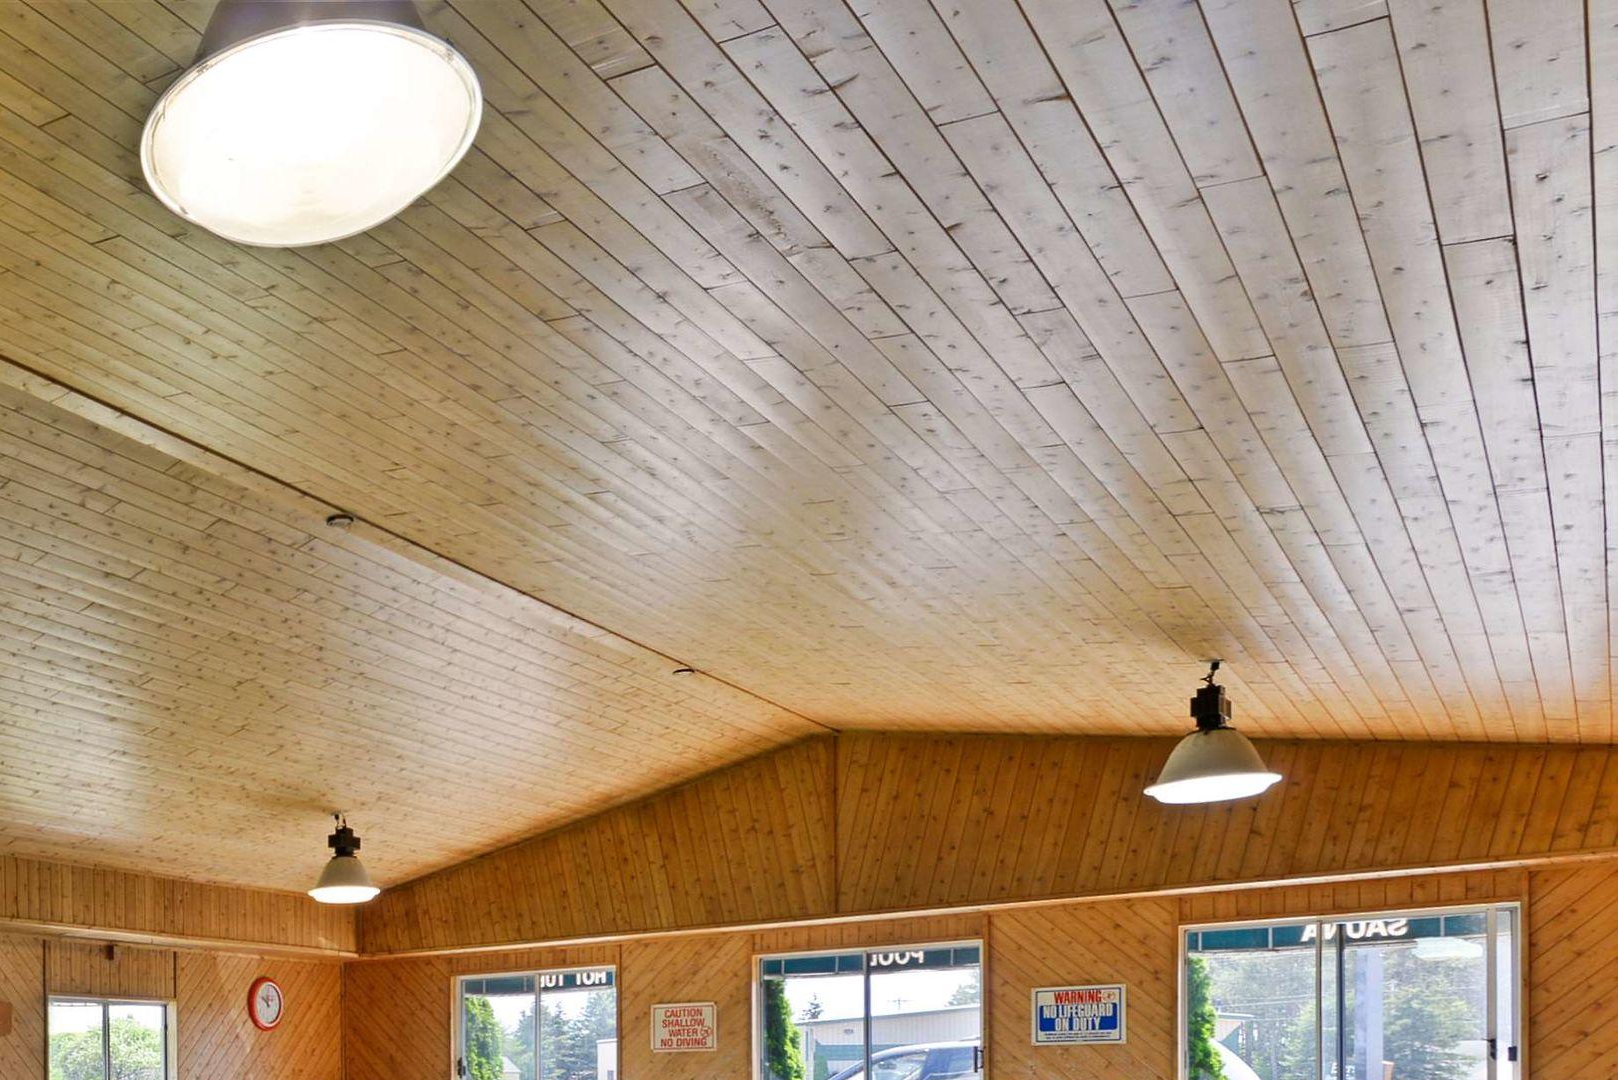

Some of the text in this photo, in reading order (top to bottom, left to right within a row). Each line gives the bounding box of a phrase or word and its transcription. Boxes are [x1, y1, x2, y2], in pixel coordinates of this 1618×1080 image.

[1054, 990, 1102, 1004] WARNING
[664, 1008, 703, 1018] CAUTION
[1043, 1003, 1113, 1018] NO LIFEGUARD
[662, 1018, 705, 1028] SHALLOW
[1055, 1017, 1101, 1031] ON DUTY
[669, 1028, 698, 1037] WATER
[661, 1037, 707, 1047] NO DIVING
